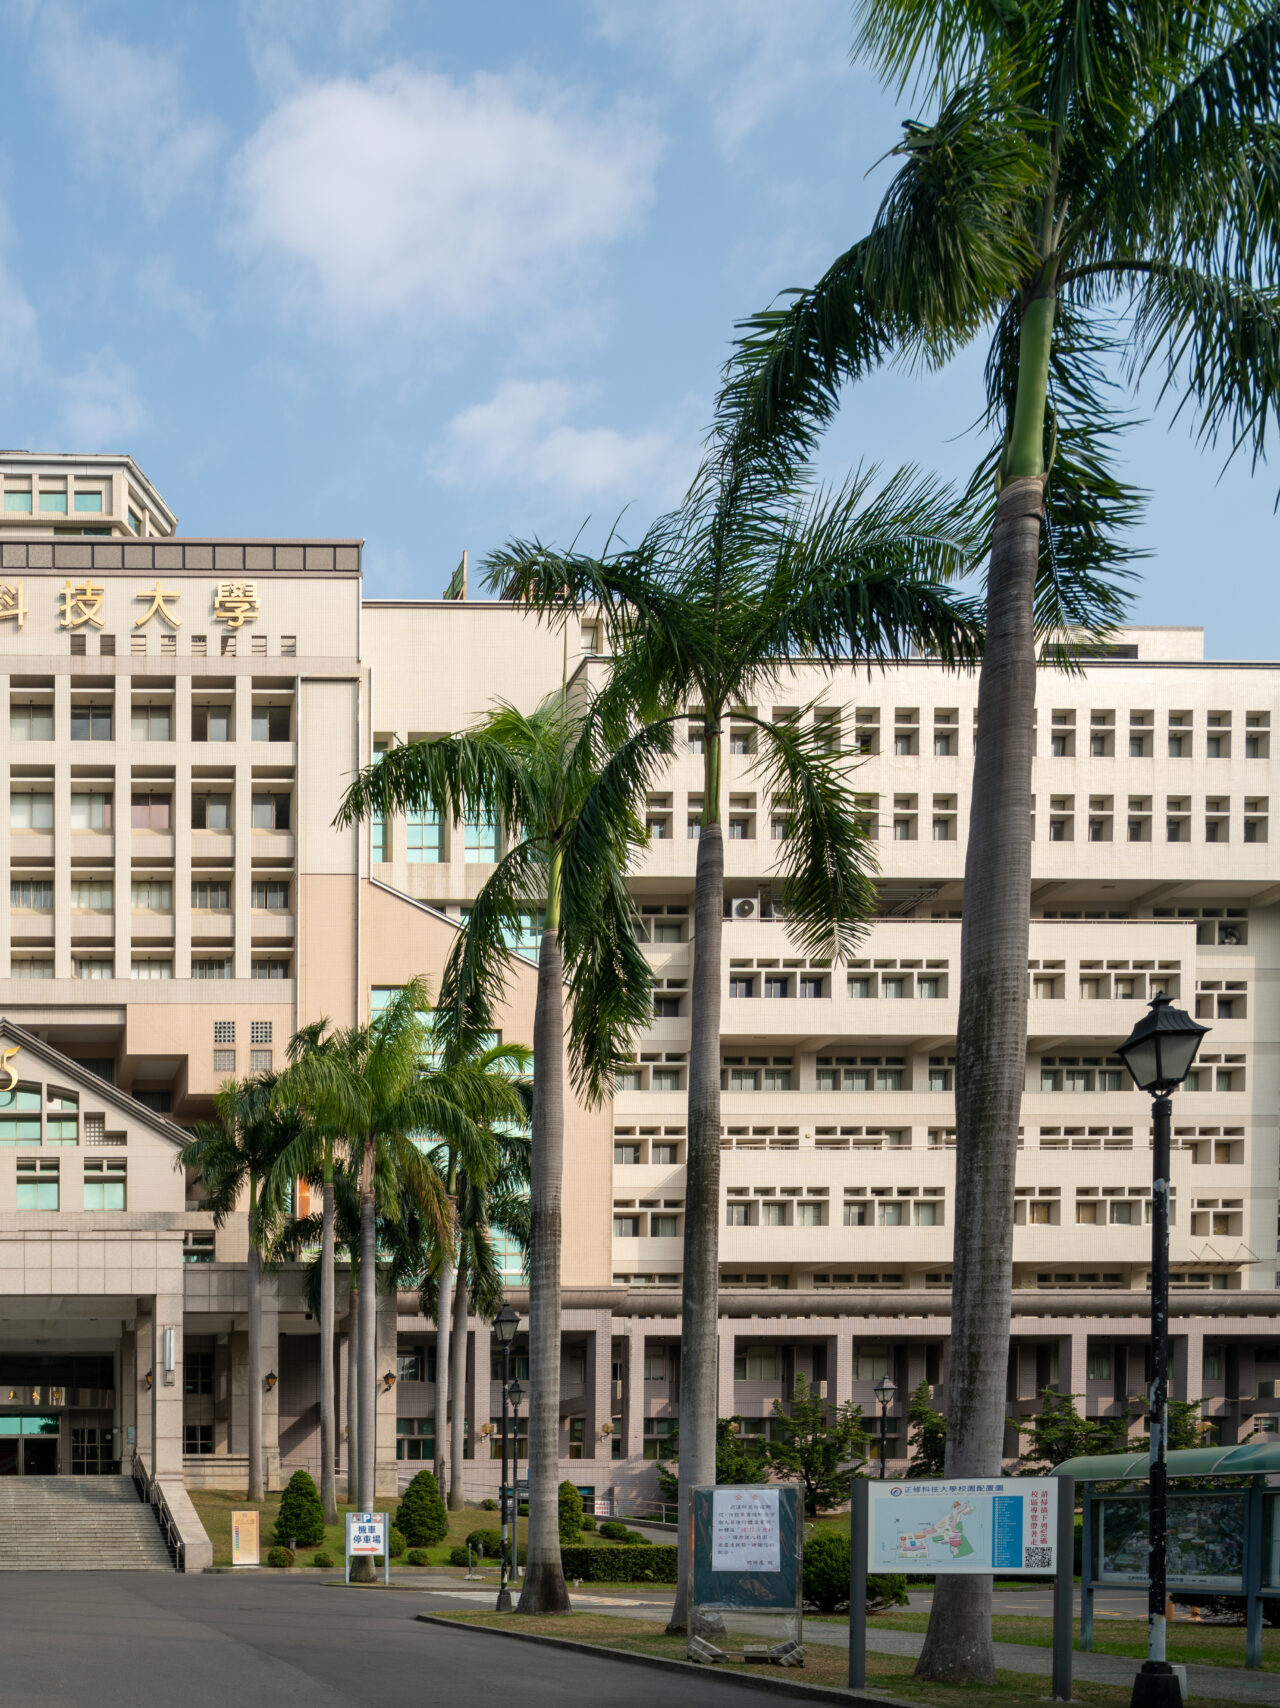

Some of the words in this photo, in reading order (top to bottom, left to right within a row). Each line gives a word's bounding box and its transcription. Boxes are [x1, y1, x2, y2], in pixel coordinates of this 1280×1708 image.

[358, 1525, 376, 1534] 機車
[353, 1535, 380, 1544] 停車場
